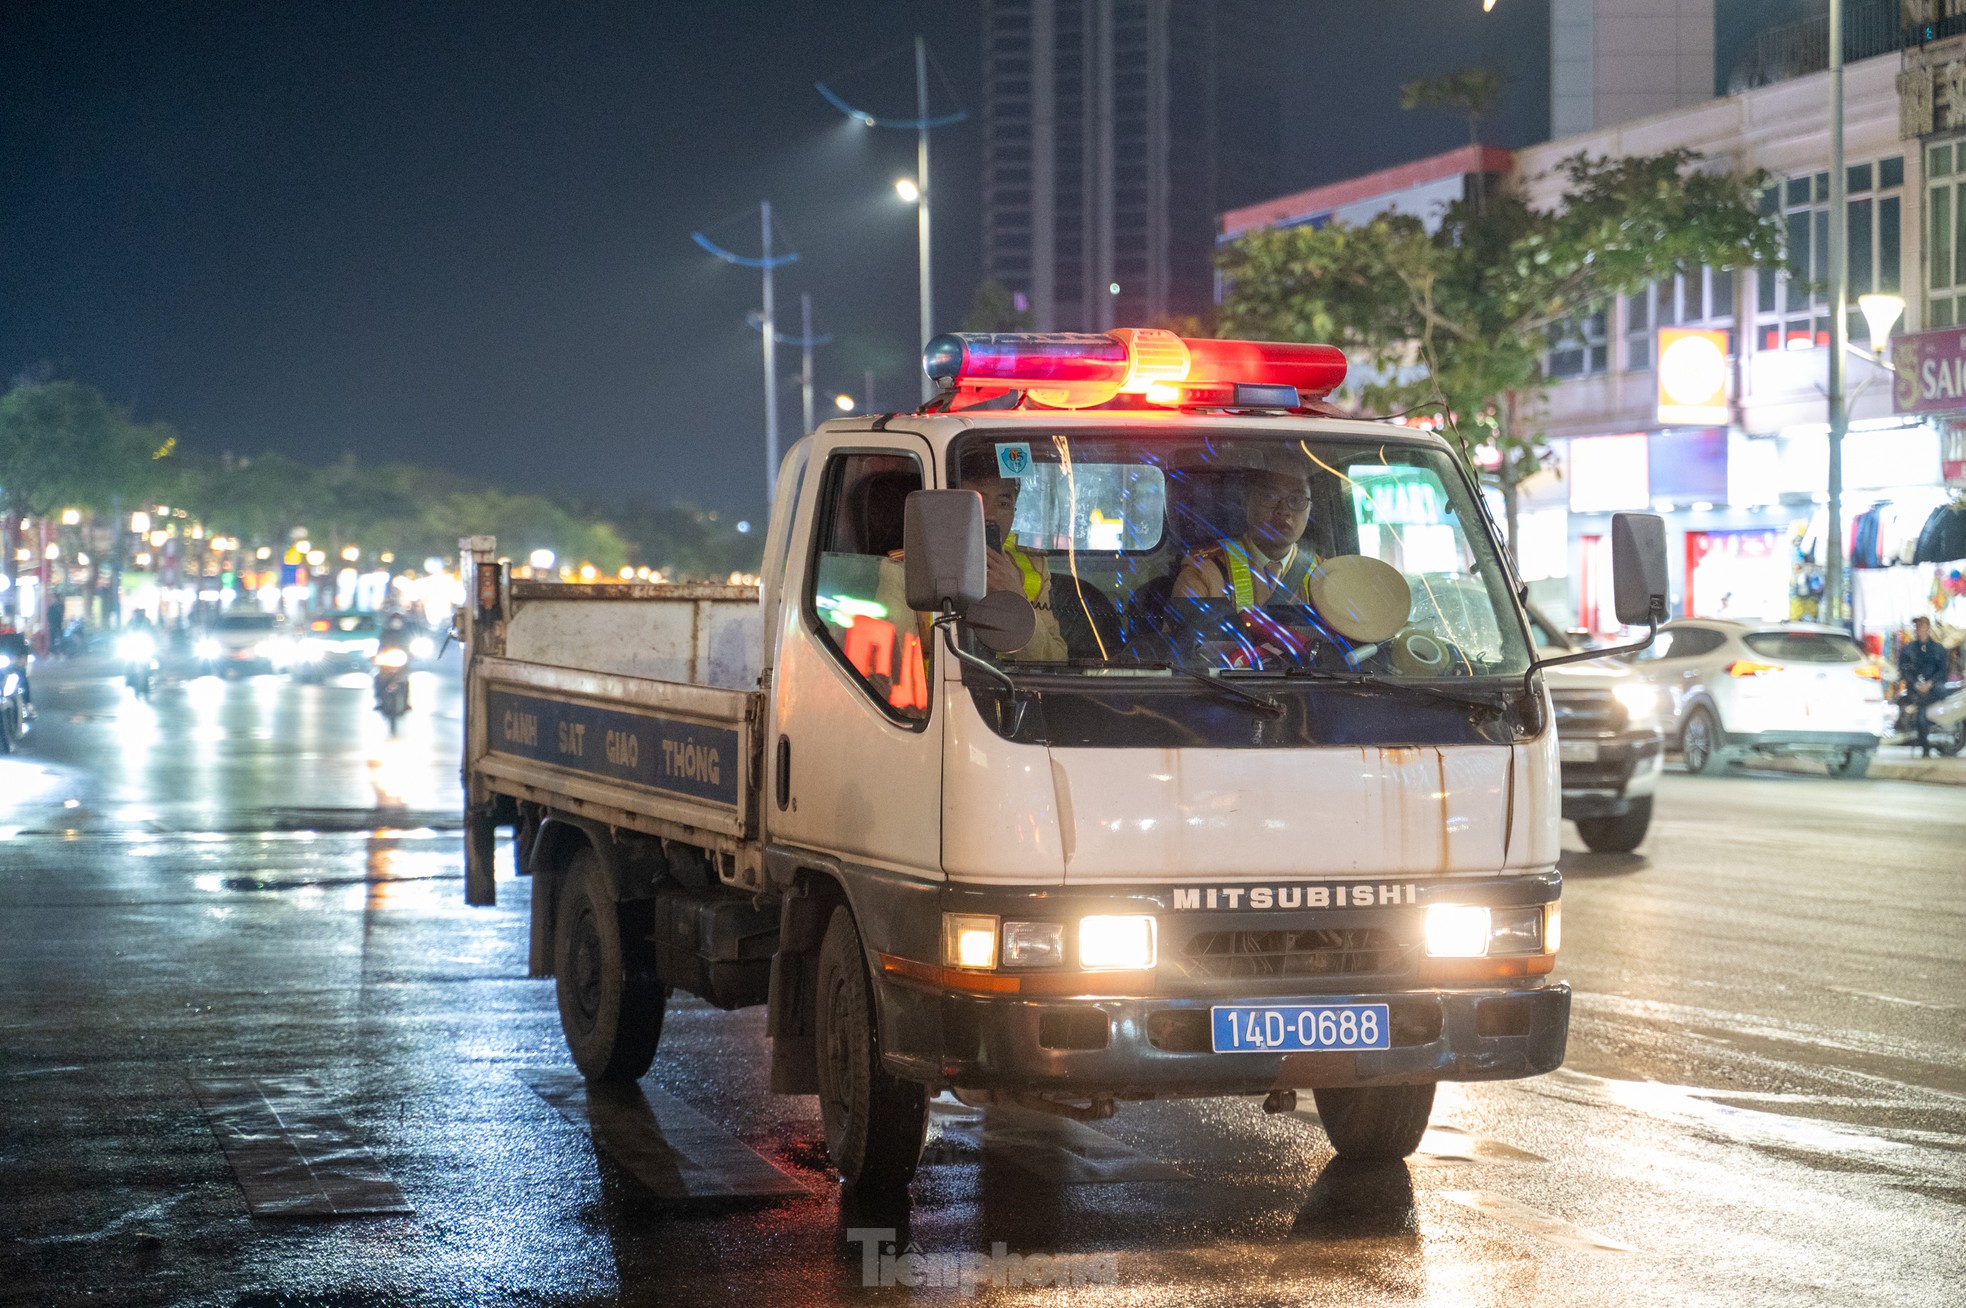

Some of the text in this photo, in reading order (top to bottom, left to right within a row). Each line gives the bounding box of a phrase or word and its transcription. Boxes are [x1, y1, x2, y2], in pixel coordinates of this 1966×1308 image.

[1922, 356, 1966, 400] SAI
[606, 729, 639, 769] GIAO
[662, 736, 720, 785] THÔNG
[1173, 884, 1416, 910] MITSUBISHI
[1227, 1010, 1379, 1048] 14D-0688
